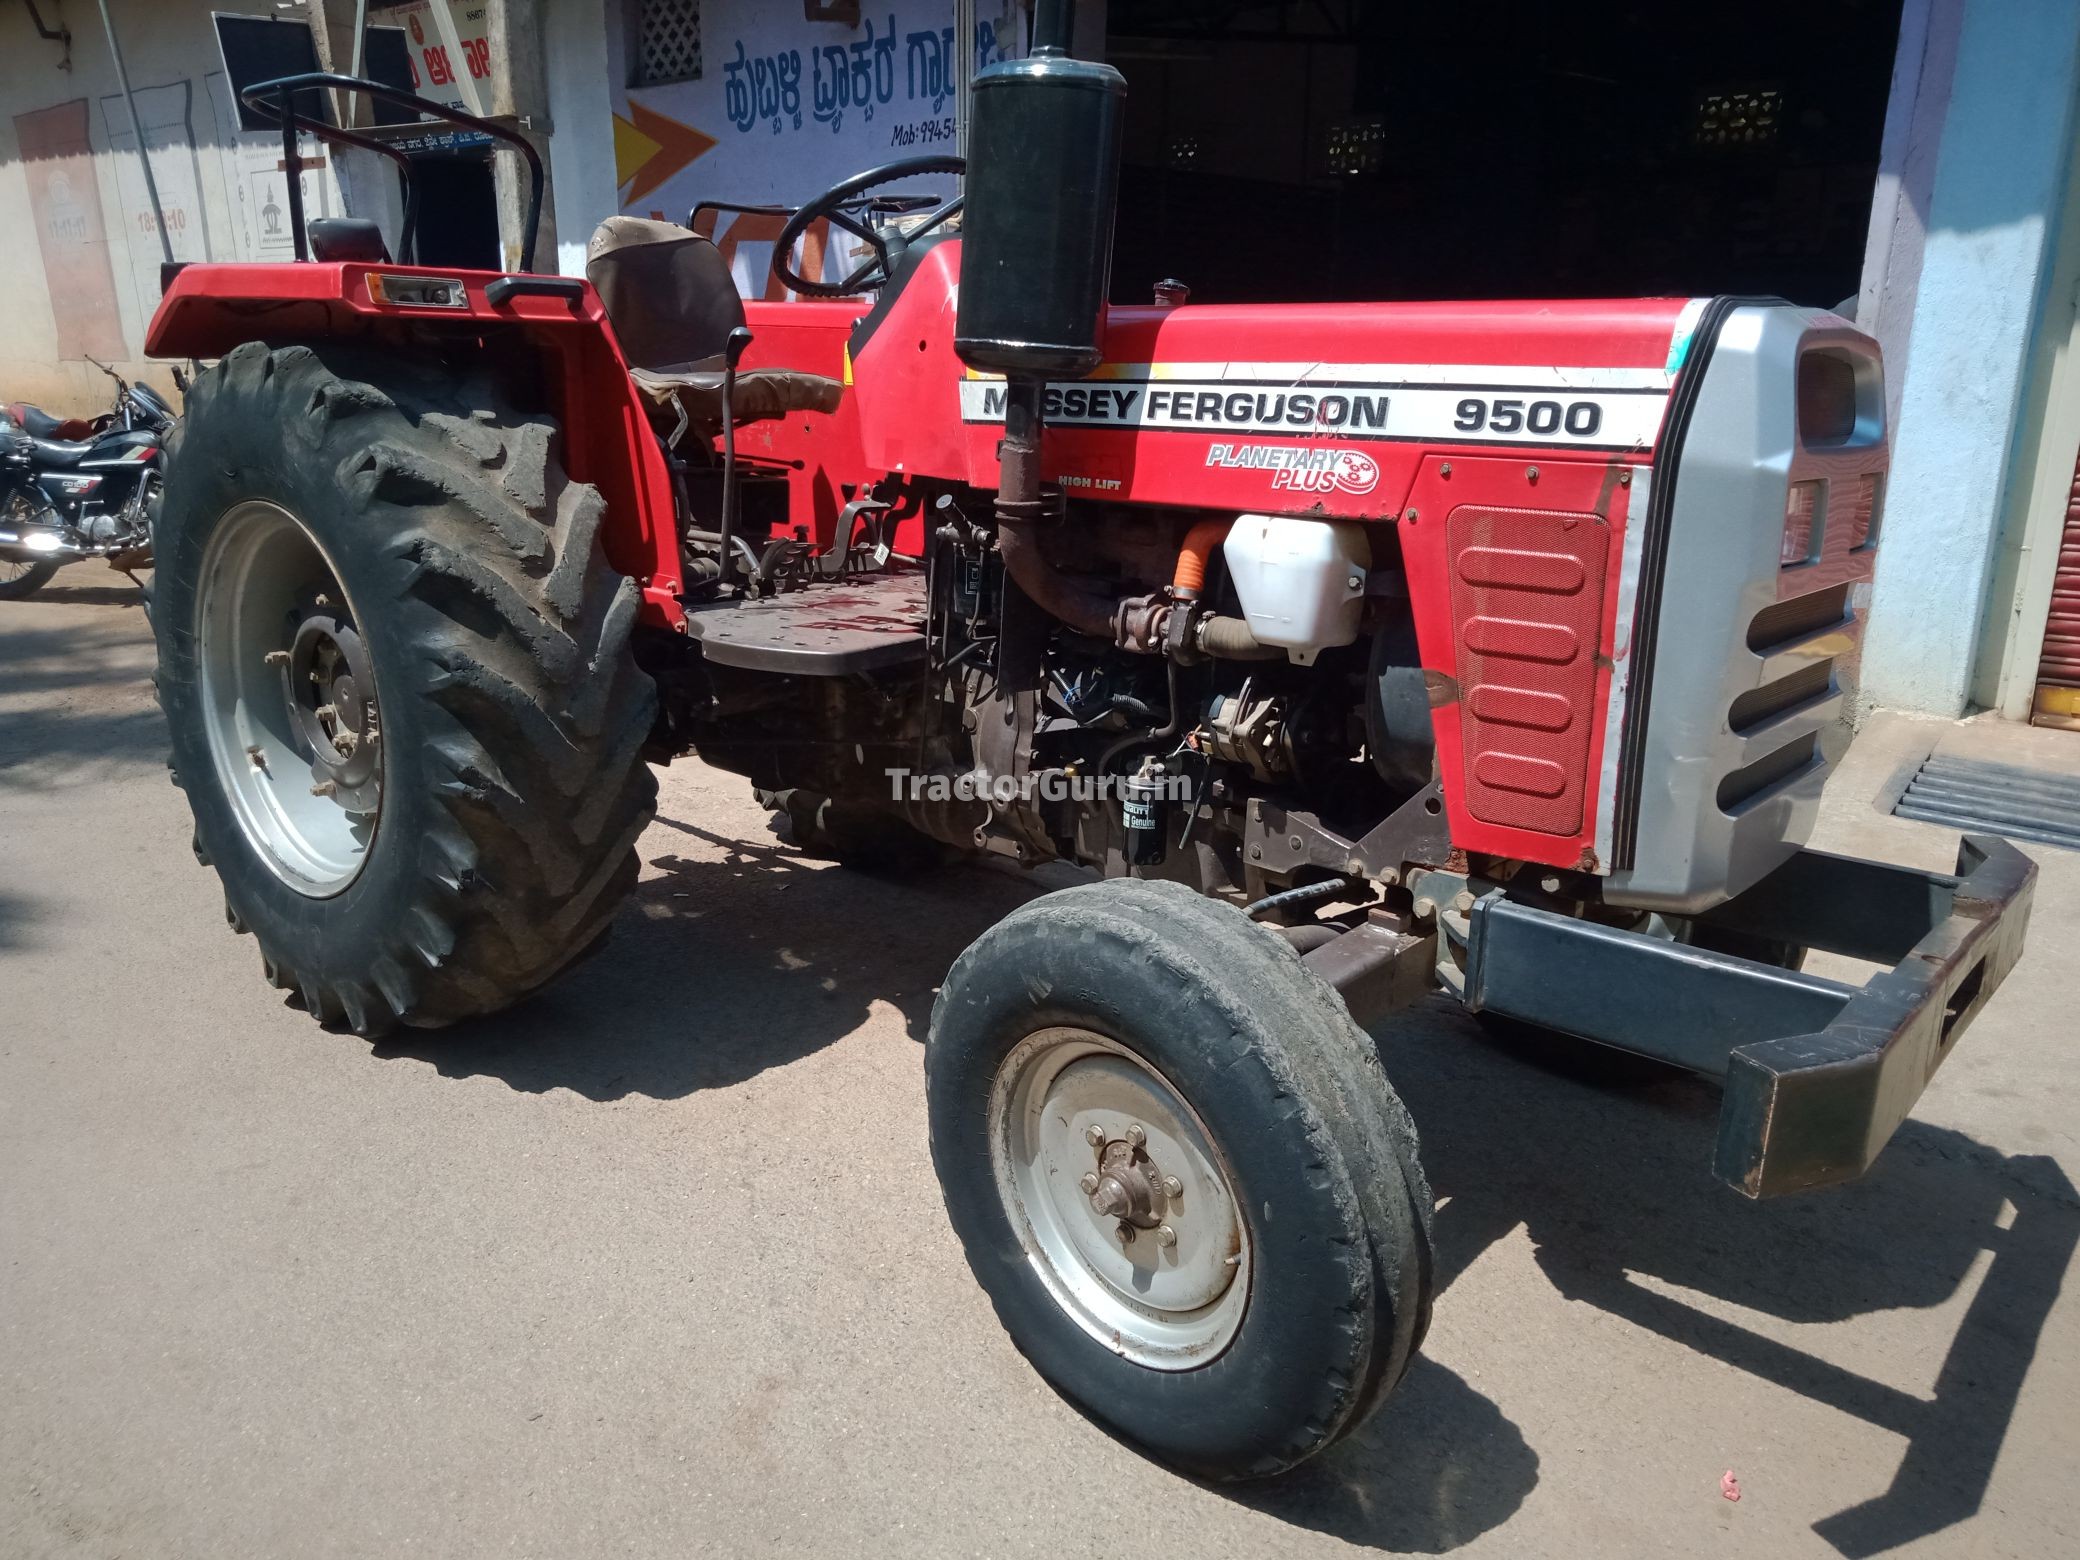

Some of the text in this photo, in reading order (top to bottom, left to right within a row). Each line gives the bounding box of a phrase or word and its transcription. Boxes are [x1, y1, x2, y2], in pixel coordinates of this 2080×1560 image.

[983, 387, 1603, 437] MSSEY FERGUSON 9500
[1205, 444, 1346, 471] PLANETARY
[1058, 475, 1122, 491] HIGH LIFT
[1271, 467, 1337, 492] PLUS
